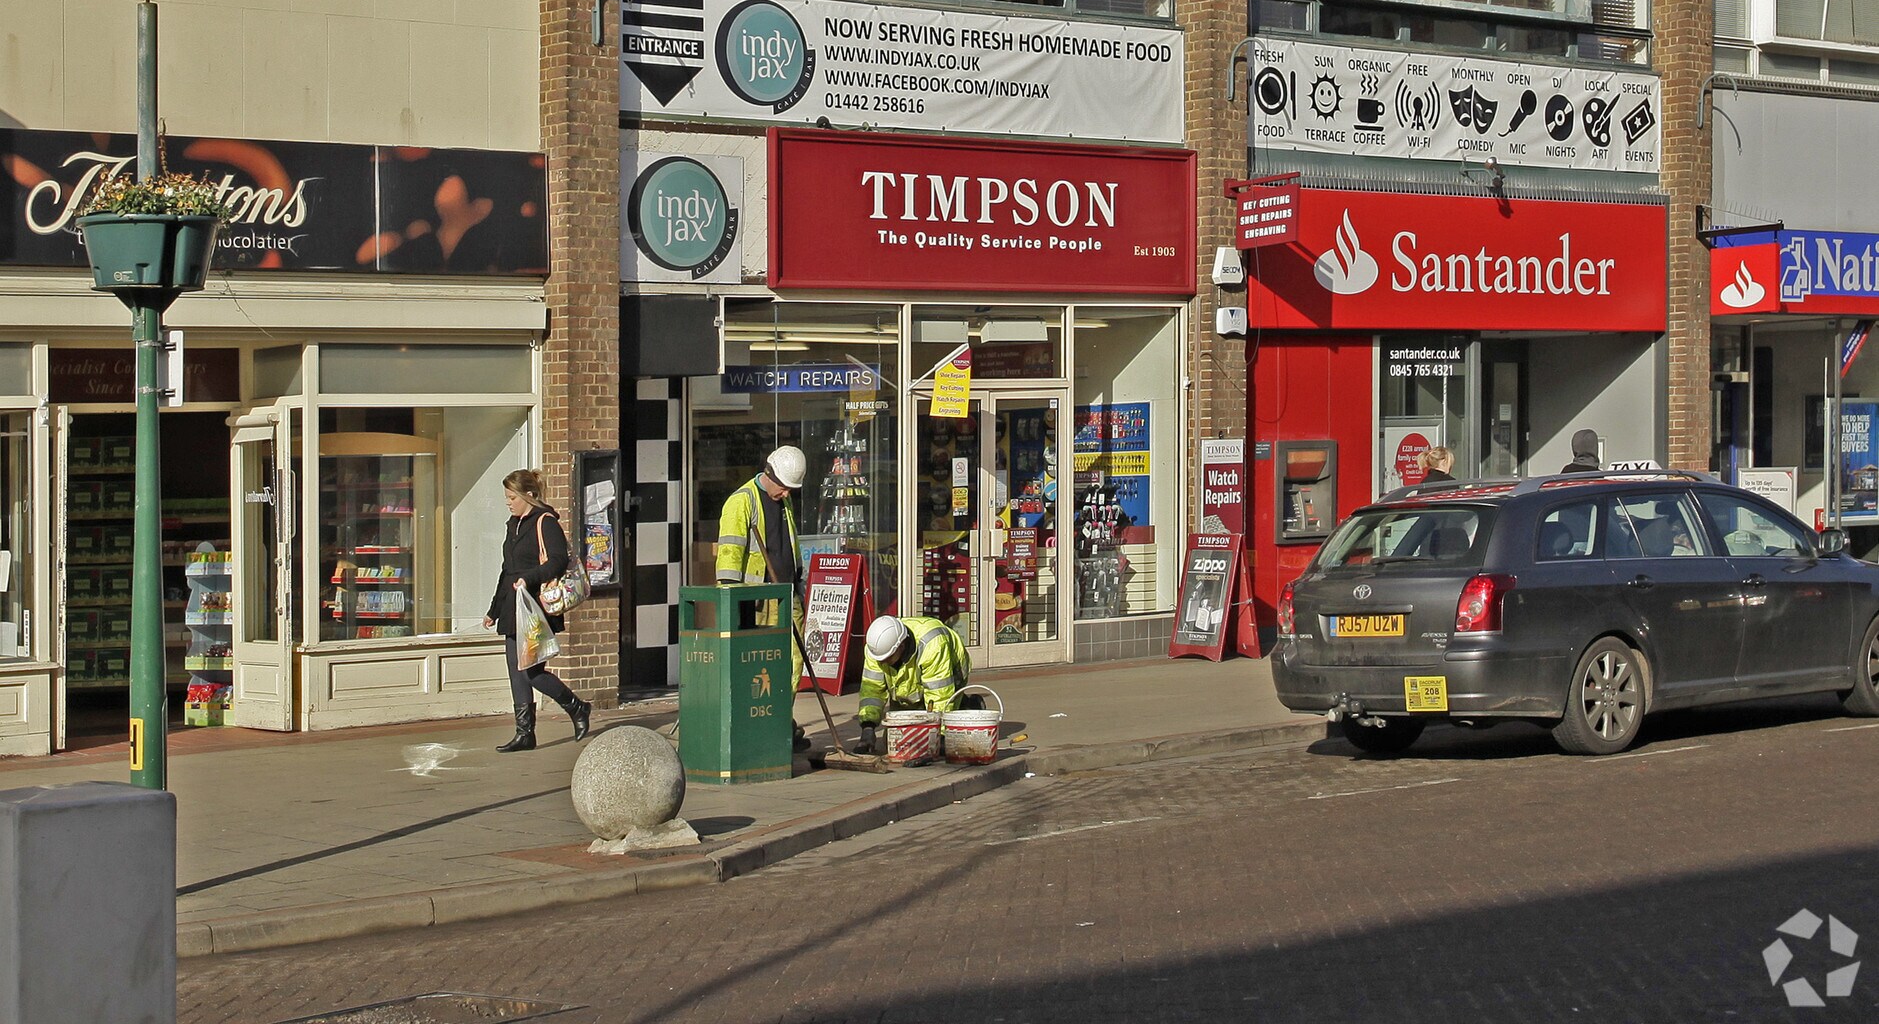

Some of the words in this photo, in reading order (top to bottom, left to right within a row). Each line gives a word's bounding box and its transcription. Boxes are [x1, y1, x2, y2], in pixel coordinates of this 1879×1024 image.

[628, 35, 699, 56] ENTRANCE
[741, 29, 797, 65] indy
[824, 17, 873, 40] NOW
[878, 22, 955, 47] SERVING
[961, 29, 1013, 51] FRESH
[1019, 33, 1122, 59] HOMEMADE
[1126, 42, 1172, 63] FOOD
[824, 45, 981, 72] WWW.INDYJAX.CO.UK
[1255, 49, 1284, 64] FRESH
[1314, 55, 1335, 69] SUN
[748, 56, 787, 82] jax
[805, 56, 813, 79] BAR
[1348, 59, 1392, 74] ORGANIC
[1407, 64, 1428, 77] FREE
[1451, 67, 1495, 82] MONTHLY
[1507, 73, 1531, 86] OPEN
[824, 69, 1050, 99] WWW.FACEBOOK.COM/INDYJAX
[1552, 77, 1562, 89] DJ
[1584, 80, 1610, 92] LOCAL
[1622, 82, 1652, 96] SPECIAL
[825, 92, 869, 111] 01442
[873, 96, 925, 114] 258616
[1257, 124, 1285, 138] FOOD
[1305, 128, 1346, 143] TERRACE
[1353, 132, 1386, 146] COFFEE
[1407, 136, 1431, 148] WI-FI
[1458, 138, 1495, 152] COMEDY
[1509, 143, 1527, 155] MIC
[1545, 146, 1576, 158] NIGHTS
[1592, 149, 1609, 160] ART
[1625, 151, 1654, 163] EVENTS
[861, 171, 1118, 228] TIMPSON
[1243, 201, 1257, 211] KEY
[1259, 195, 1291, 209] CUTTING
[657, 189, 718, 228] indy
[1240, 214, 1259, 225] SHOE
[1261, 209, 1292, 222] REPAIRS
[664, 217, 707, 247] jax
[726, 216, 736, 240] BAR
[1244, 225, 1287, 239] ENGRAVING
[878, 229, 908, 245] The
[914, 231, 974, 250] Quality
[981, 234, 1042, 249] Service
[1049, 236, 1102, 253] People
[1133, 245, 1149, 257] Est
[1152, 246, 1176, 258] 1903
[1392, 231, 1615, 295] Santander
[1389, 346, 1461, 360] santander.co.uk
[1389, 364, 1412, 376] 0845
[1414, 364, 1430, 376] 765
[1432, 364, 1453, 376] 4321
[729, 371, 788, 387] WATCH
[800, 370, 872, 387] REPAIRS
[86, 378, 123, 394] Since
[845, 401, 860, 410] HALF
[860, 401, 875, 409] PRICE
[1841, 422, 1851, 433] TO
[1851, 422, 1870, 433] HELP
[1206, 445, 1241, 454] TIMPSON
[1841, 441, 1869, 453] BUYERS
[1611, 462, 1650, 471] TAXI
[1208, 469, 1239, 486] Watch
[1205, 488, 1241, 508] Repairs
[1197, 536, 1231, 545] TIMPSON
[800, 544, 833, 561] atch
[819, 557, 850, 566] TIMPSON
[1193, 557, 1227, 573] zippo
[812, 589, 849, 604] Lifetime
[811, 603, 847, 614] guarantee
[1338, 616, 1370, 633] RJ57
[1373, 616, 1399, 632] UZW
[827, 632, 843, 643] PAY
[826, 642, 841, 652] ONCE
[686, 651, 714, 663] LITTER
[741, 649, 782, 663] LITTER
[1424, 687, 1440, 696] 208
[750, 704, 773, 718] DBC
